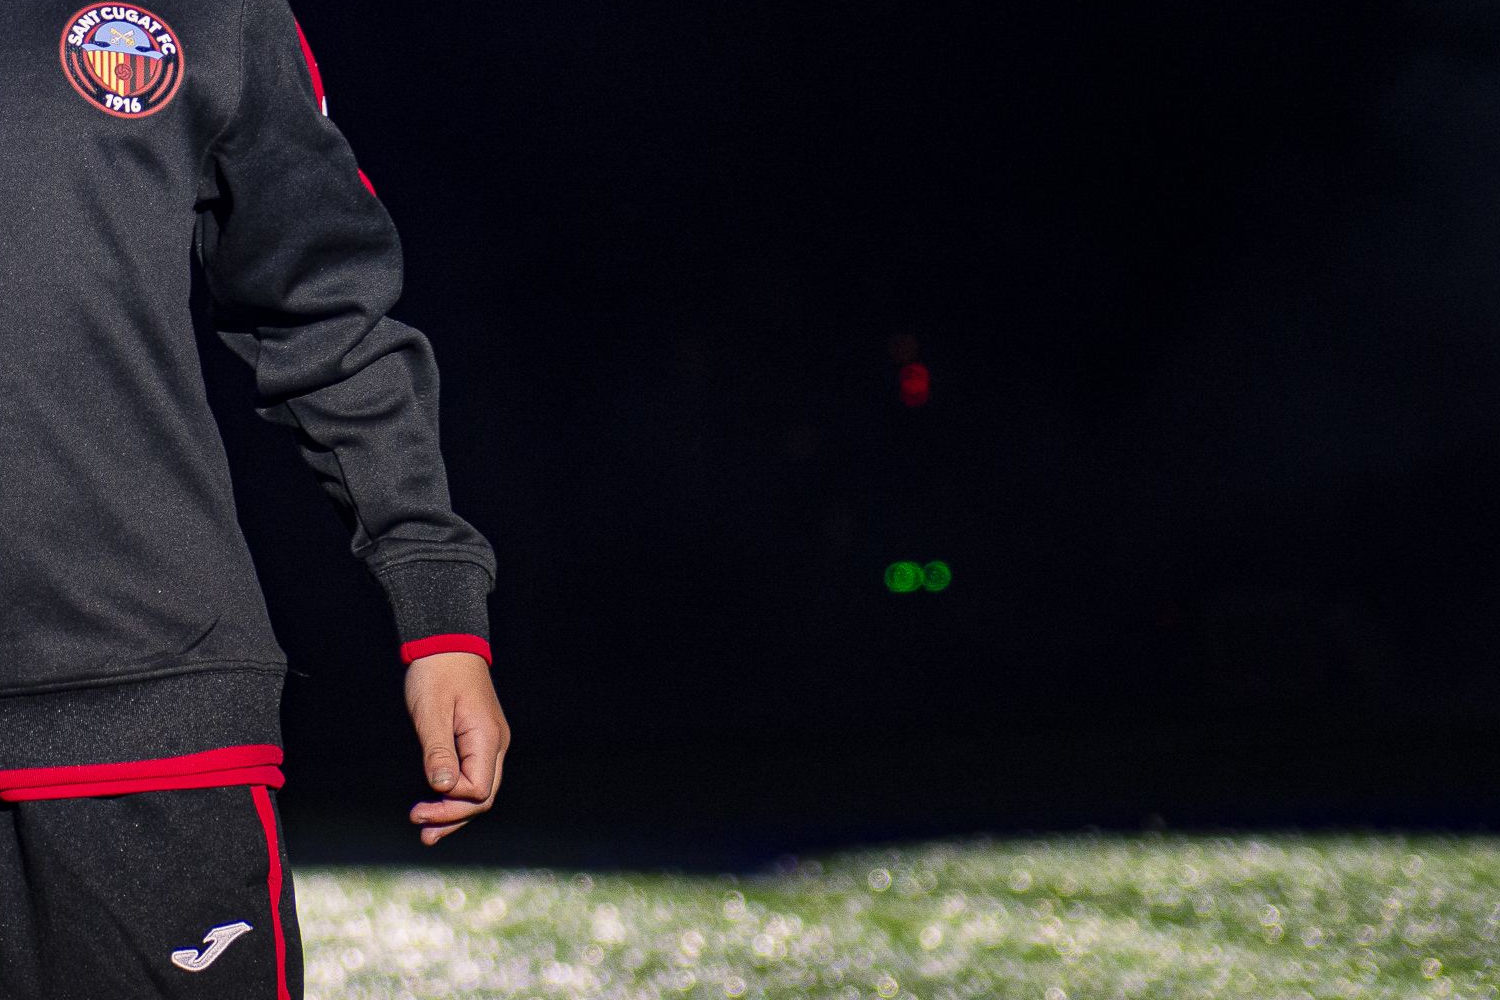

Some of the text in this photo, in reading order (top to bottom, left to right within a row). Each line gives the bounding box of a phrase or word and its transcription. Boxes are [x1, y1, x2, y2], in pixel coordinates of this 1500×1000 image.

[67, 6, 176, 56] SANT CUGAT FC
[105, 94, 142, 113] 1916
